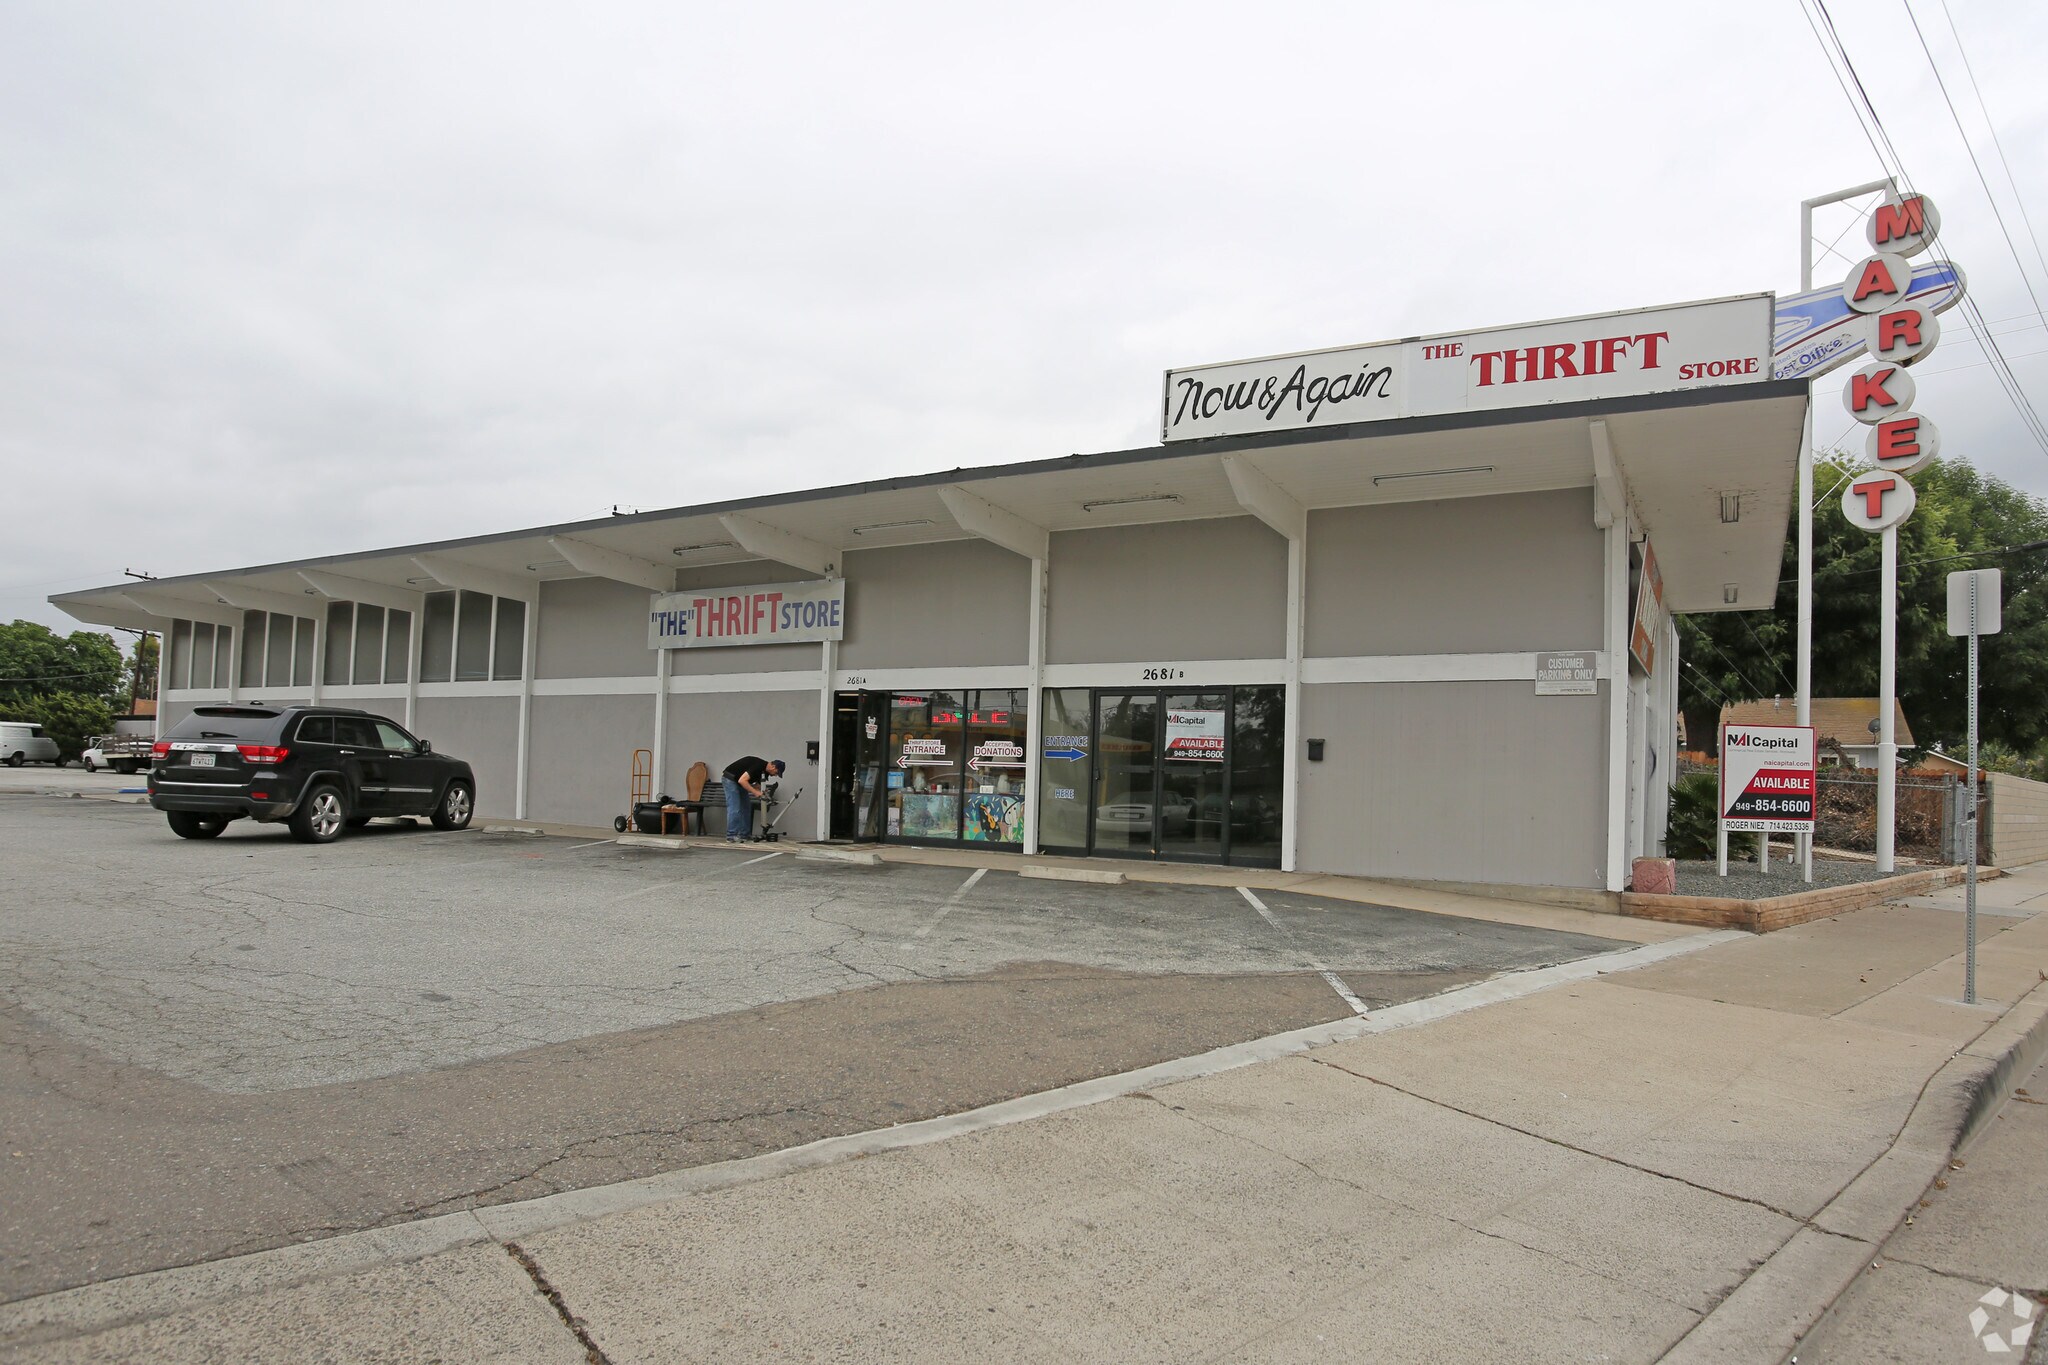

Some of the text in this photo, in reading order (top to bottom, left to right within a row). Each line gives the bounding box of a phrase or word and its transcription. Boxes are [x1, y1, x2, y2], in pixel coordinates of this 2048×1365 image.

[1422, 331, 1759, 388] THE THRIFT STORE
[651, 592, 840, 637] "THE" THRIFT STORE
[1548, 658, 1584, 669] CUSTOMER
[1143, 668, 1184, 680] 2681 B
[1538, 669, 1594, 680] PARKING ONLY
[899, 696, 922, 706] OPEN
[1044, 736, 1088, 747] ENTRANCE
[904, 745, 945, 754] ENTRANCE
[975, 747, 1022, 756] DONATIONS
[1753, 777, 1810, 789] AVAILABLE
[1055, 789, 1075, 800] HERE
[1735, 799, 1810, 813] 949-854-6600
[1726, 821, 1748, 830] ROGER
[1750, 822, 1765, 830] NIEZ
